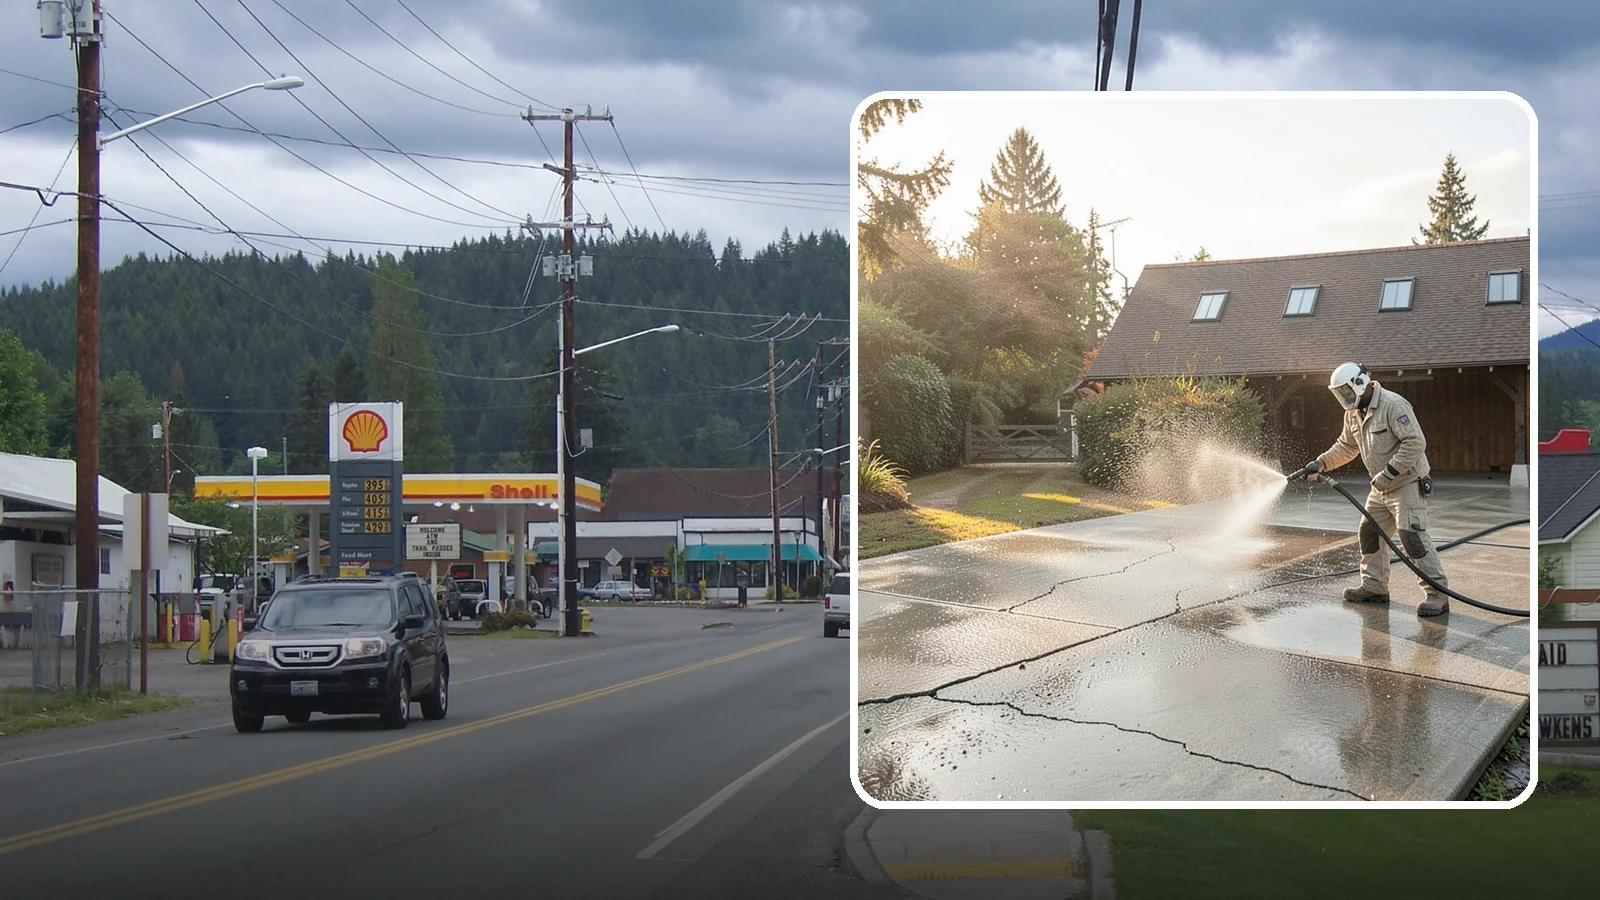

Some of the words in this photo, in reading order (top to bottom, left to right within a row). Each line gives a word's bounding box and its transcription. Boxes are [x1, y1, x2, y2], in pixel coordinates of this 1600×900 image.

[366, 480, 383, 490] 395
[490, 484, 547, 499] Shell
[366, 494, 383, 504] 405
[366, 507, 383, 518] 415
[366, 522, 383, 532] 429
